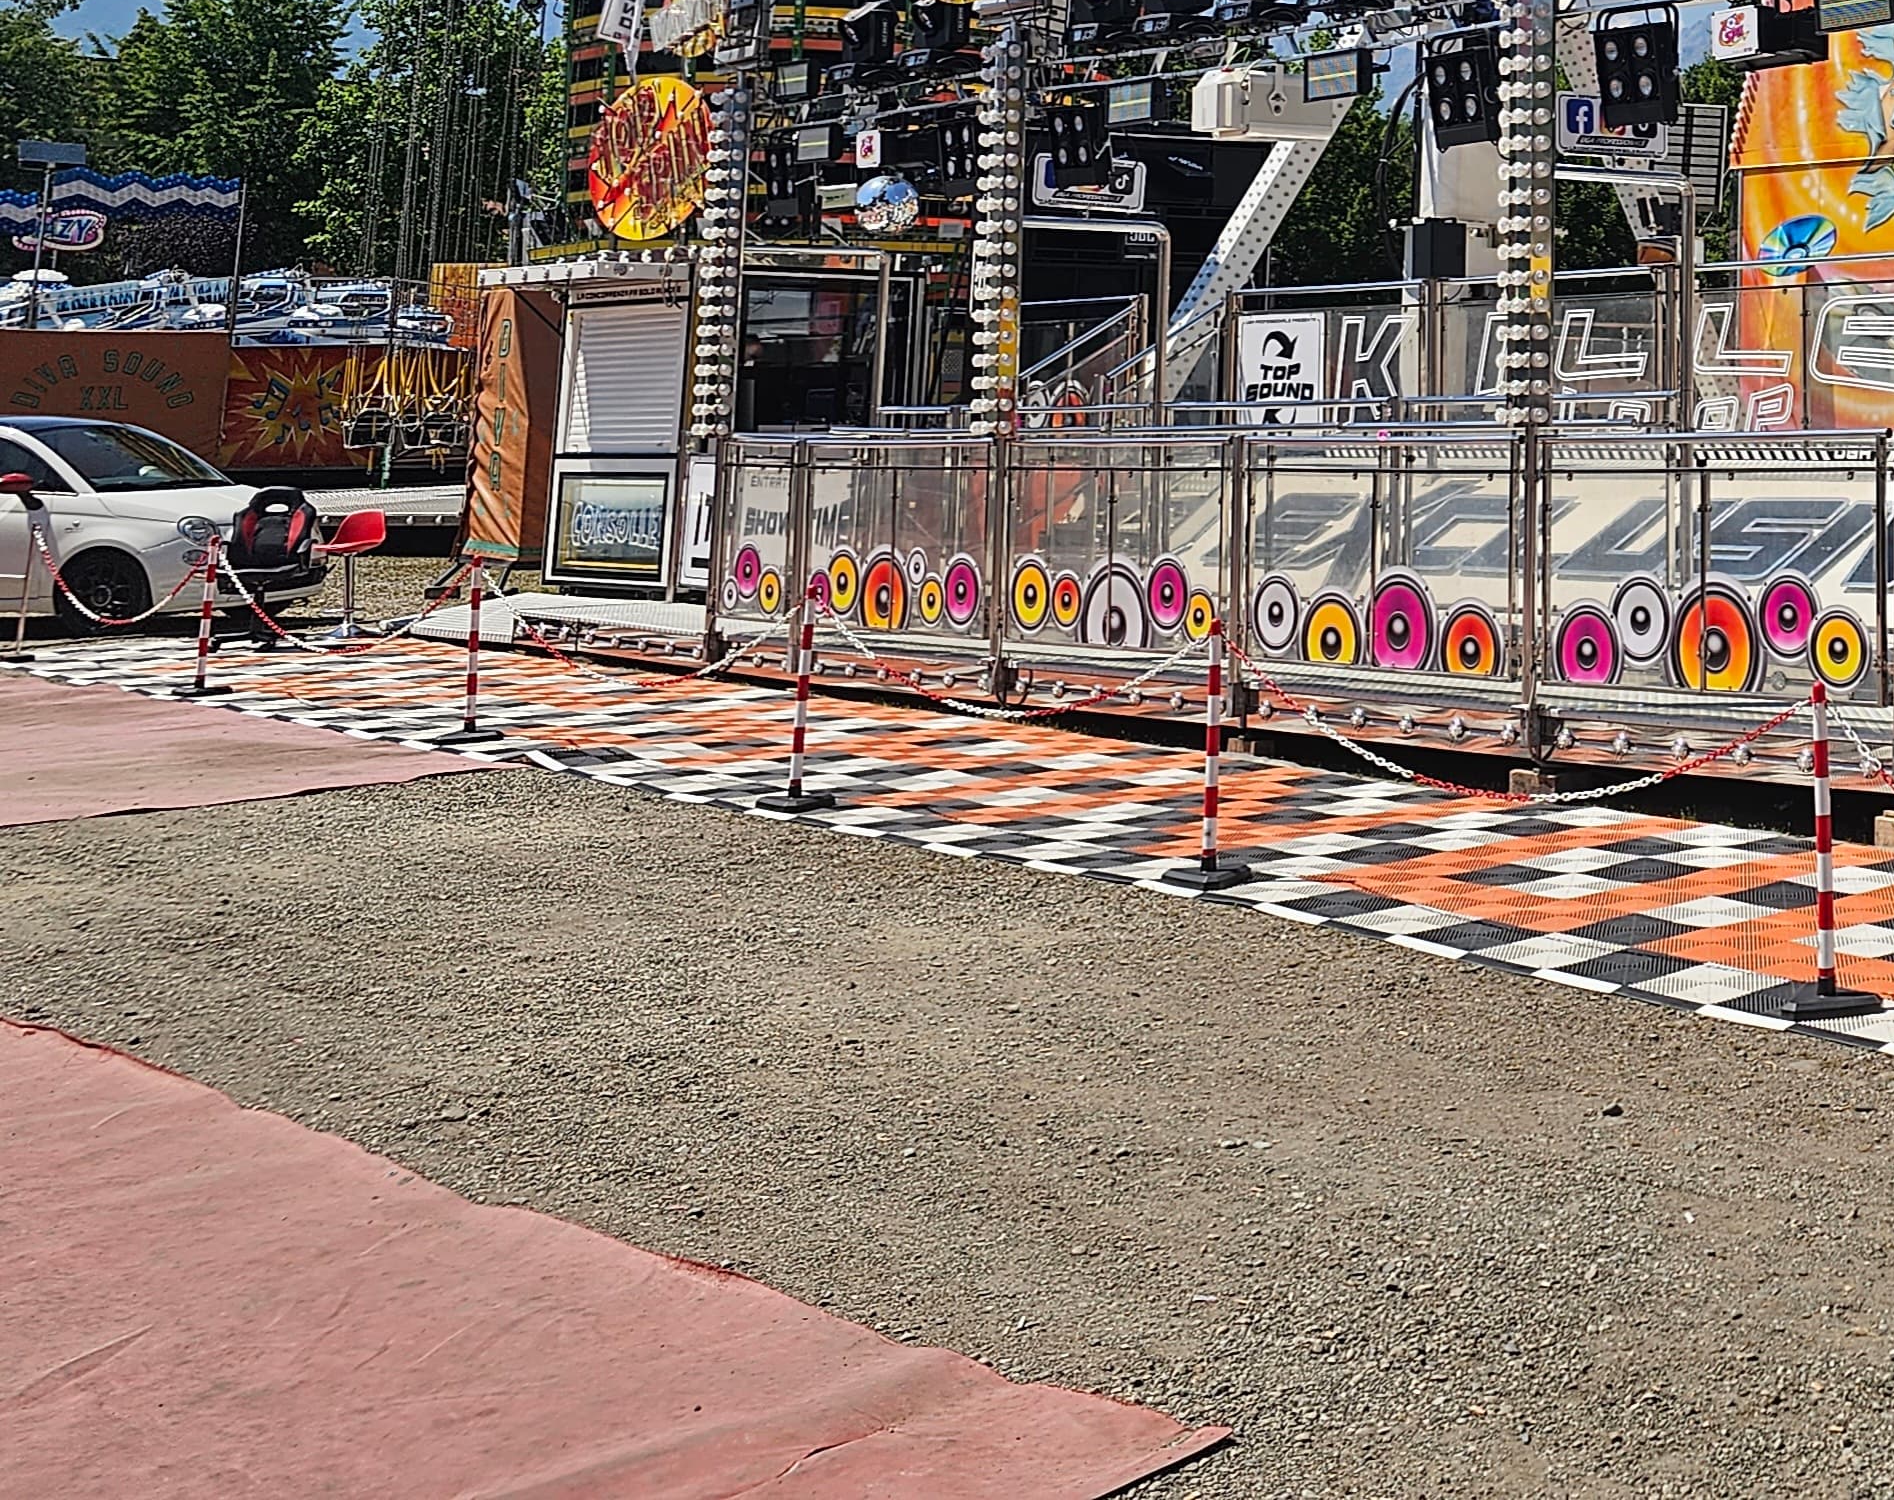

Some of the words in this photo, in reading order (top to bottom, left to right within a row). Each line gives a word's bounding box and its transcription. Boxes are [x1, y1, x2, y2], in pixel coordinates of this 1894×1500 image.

[11, 355, 79, 409] DIVA
[104, 350, 195, 409] SOUND
[1260, 362, 1301, 381] TOP
[80, 386, 129, 410] XXL
[1245, 382, 1315, 402] SOUND
[488, 318, 512, 491] DIVA
